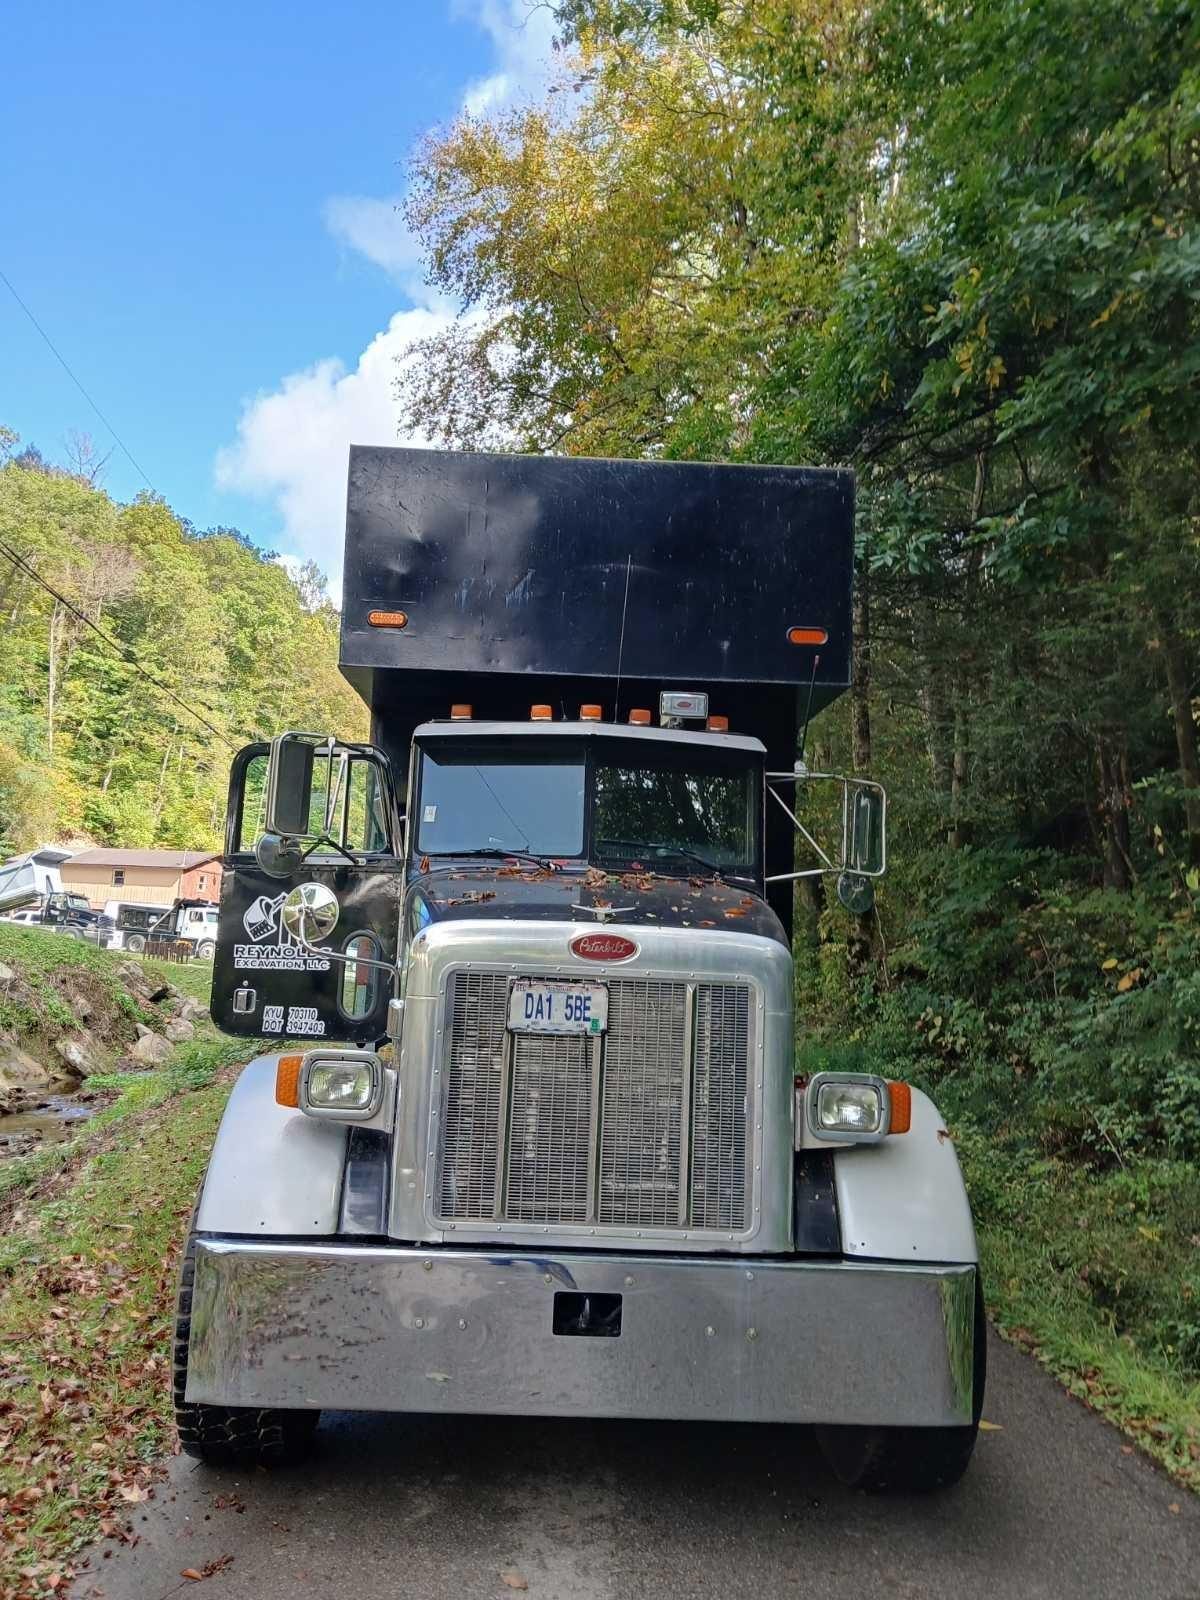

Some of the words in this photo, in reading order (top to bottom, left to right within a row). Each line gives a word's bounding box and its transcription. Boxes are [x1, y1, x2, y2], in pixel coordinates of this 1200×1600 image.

[306, 959, 331, 971] LLC
[263, 1006, 284, 1020] KYU
[288, 1007, 318, 1021] 703110
[525, 993, 552, 1020] DA1
[564, 995, 592, 1022] 5BE
[262, 1019, 284, 1032] DOT
[286, 1020, 325, 1034] 3947403
